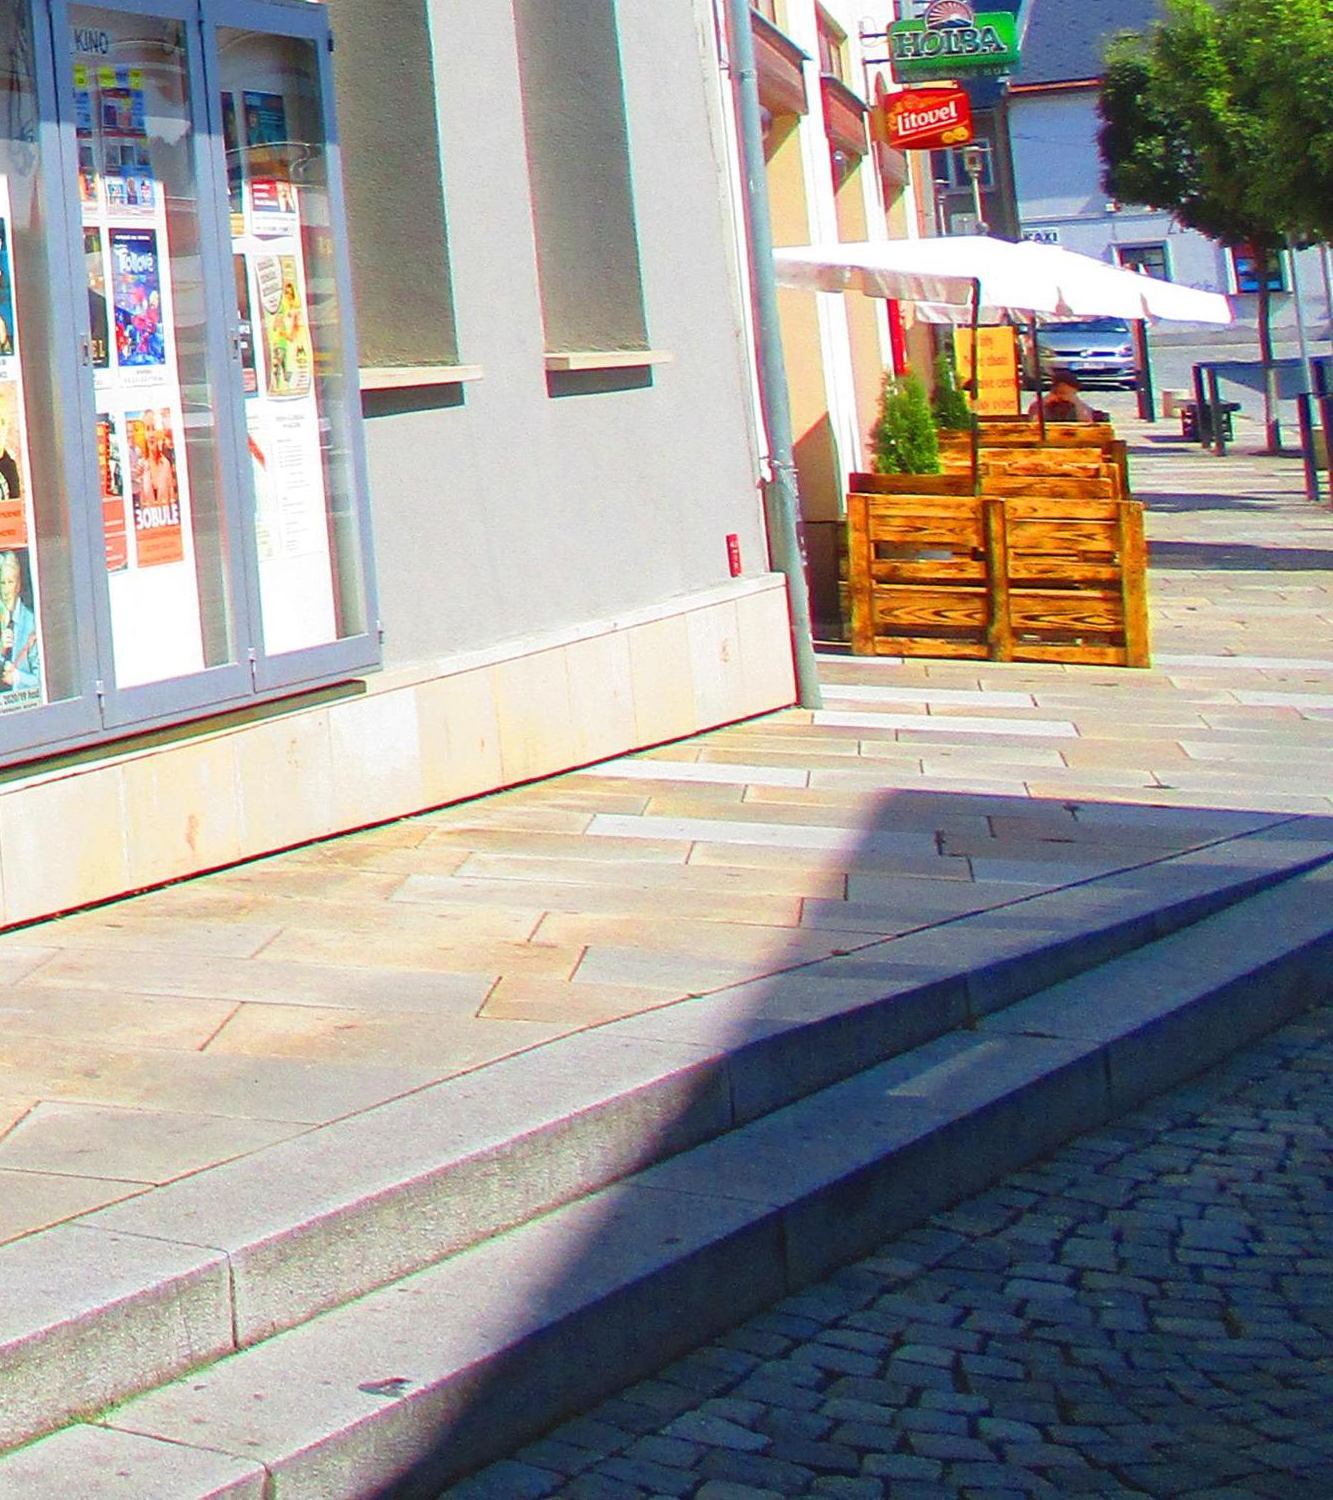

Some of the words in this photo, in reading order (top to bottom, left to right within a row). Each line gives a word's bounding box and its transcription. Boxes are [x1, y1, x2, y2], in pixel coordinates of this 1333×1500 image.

[74, 29, 109, 54] KINO
[893, 26, 1009, 60] HOLBA
[897, 101, 958, 136] Litovel
